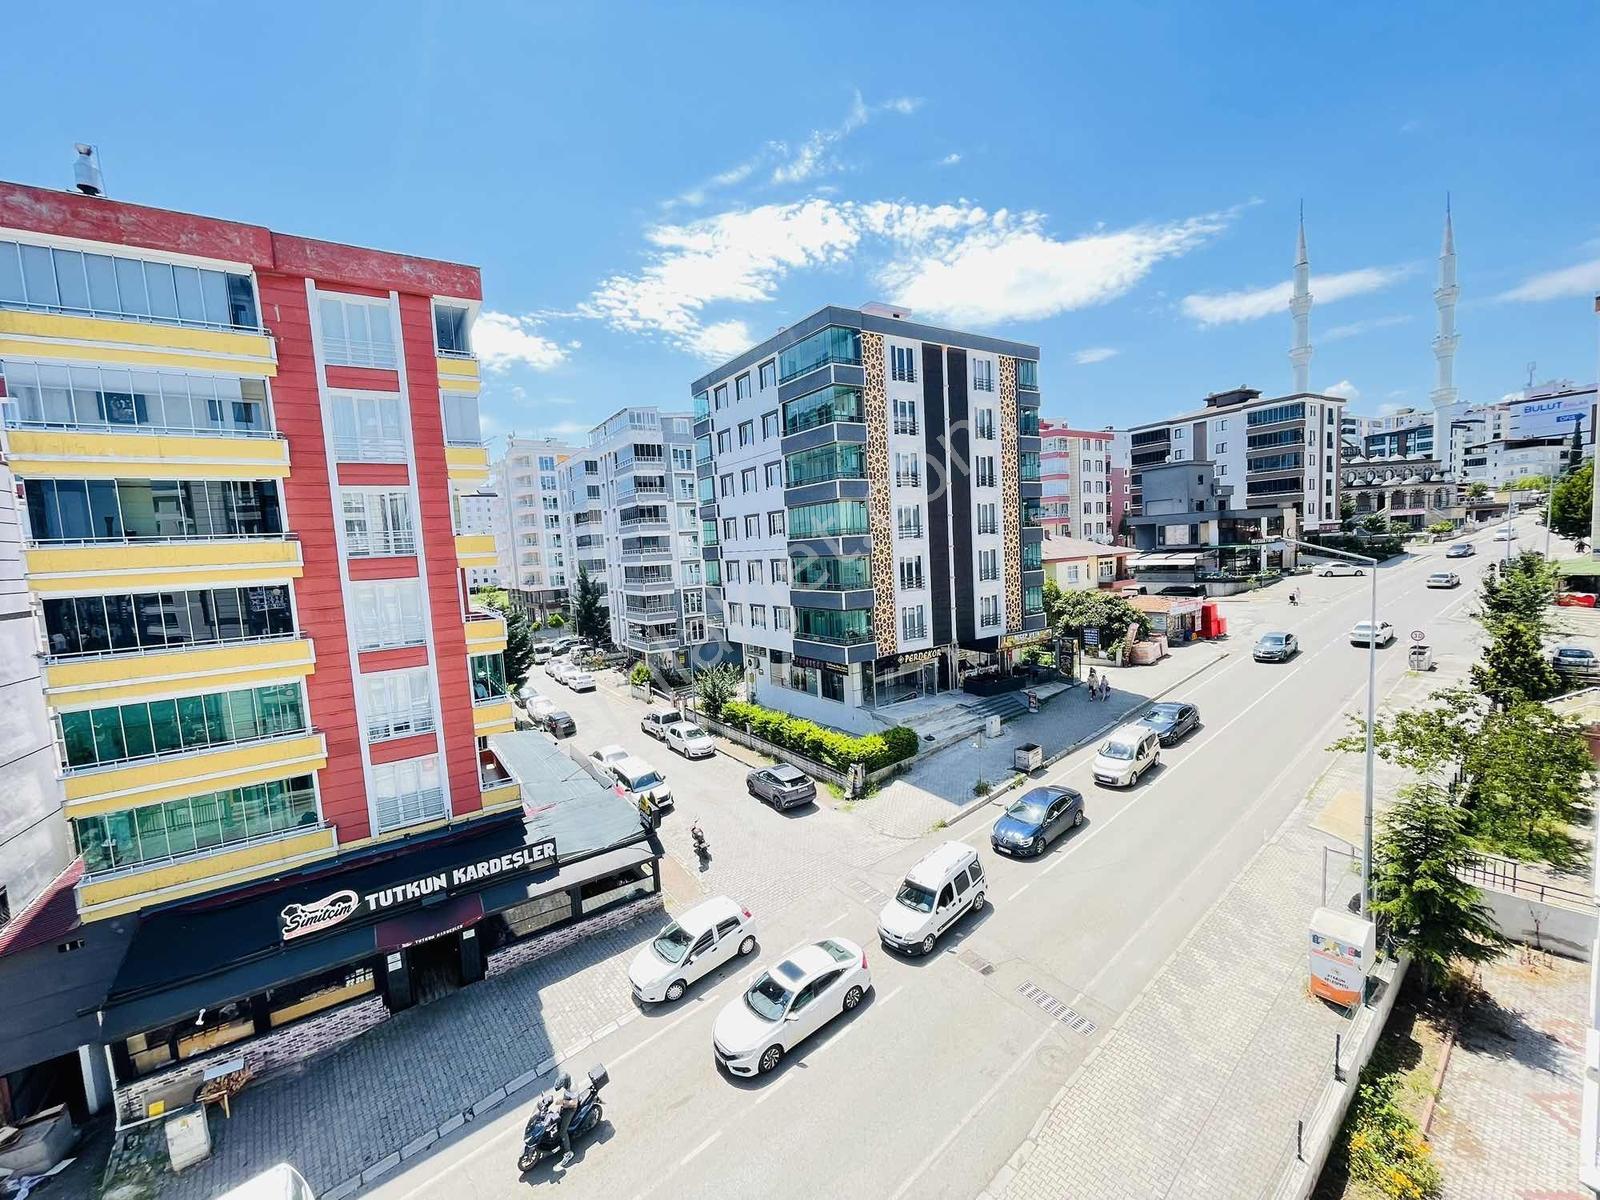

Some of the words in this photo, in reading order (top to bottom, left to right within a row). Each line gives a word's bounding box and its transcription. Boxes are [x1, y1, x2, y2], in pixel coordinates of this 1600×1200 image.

[1524, 401, 1563, 413] BULUT
[904, 649, 942, 663] PERDEKOR
[365, 873, 447, 911] TUTKUN
[453, 843, 555, 885] KARDEŞLER
